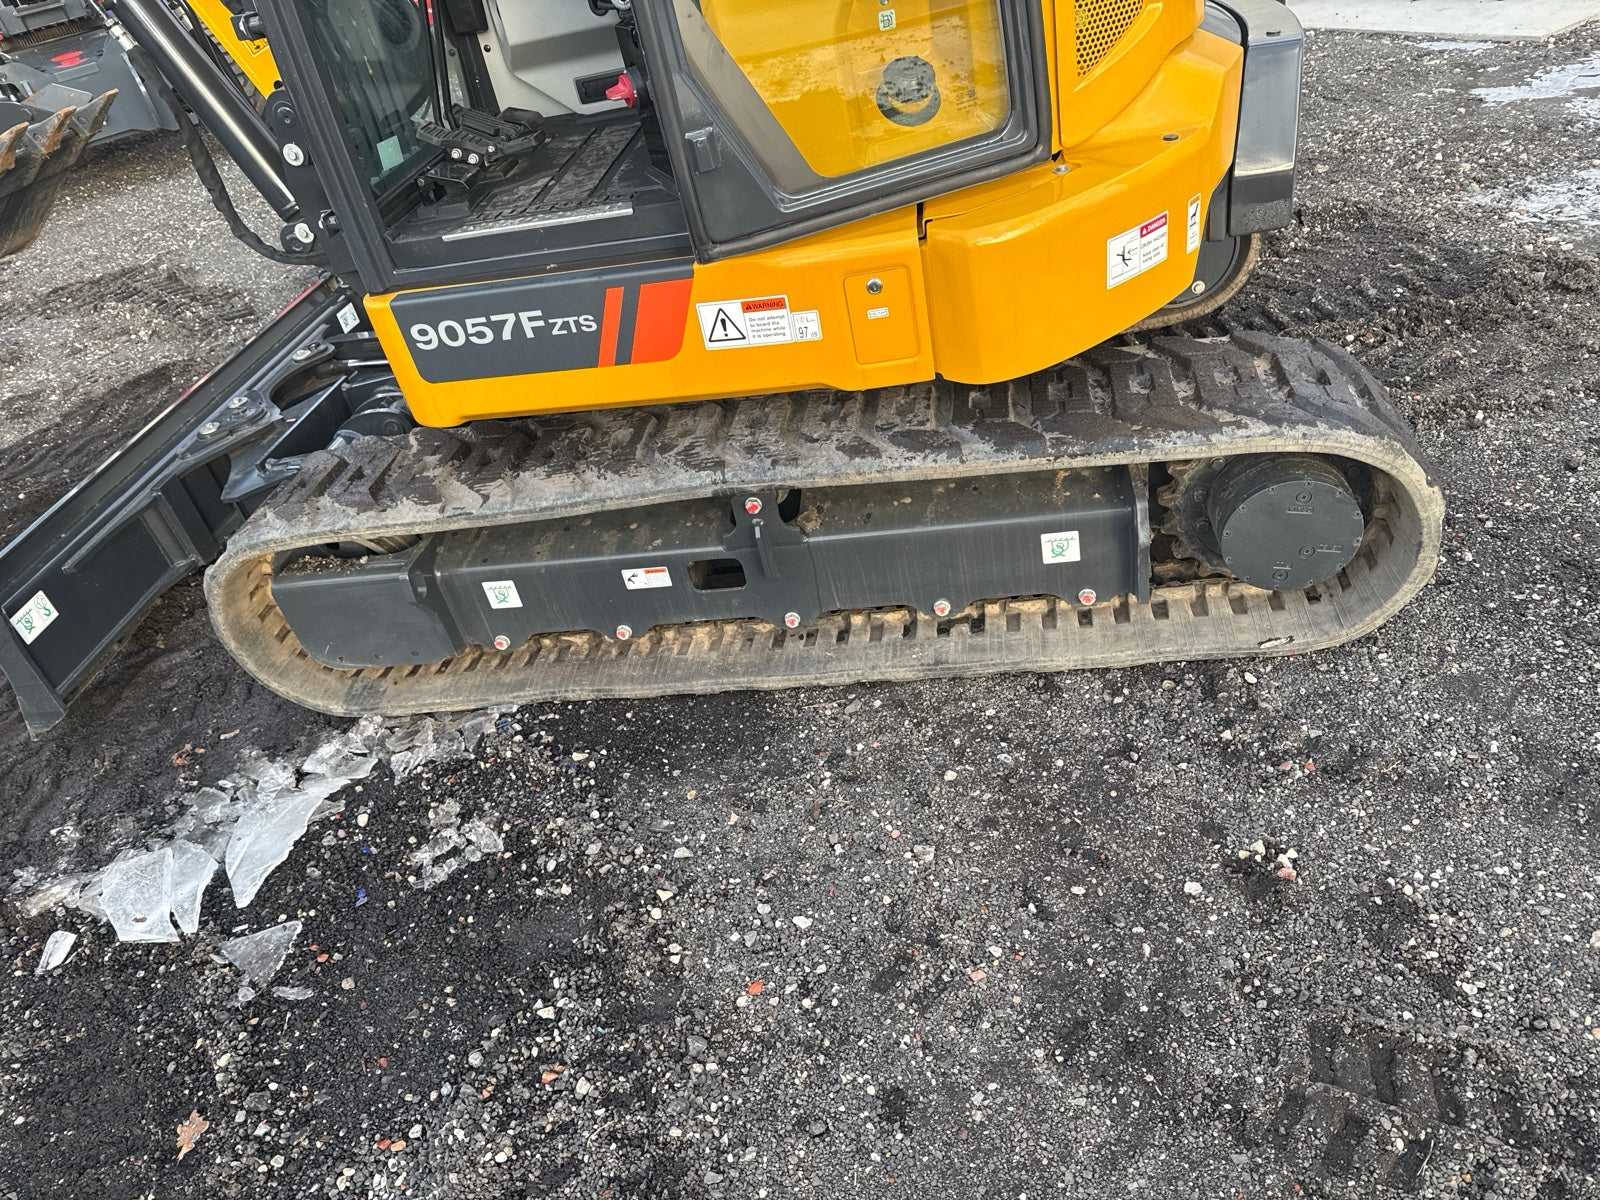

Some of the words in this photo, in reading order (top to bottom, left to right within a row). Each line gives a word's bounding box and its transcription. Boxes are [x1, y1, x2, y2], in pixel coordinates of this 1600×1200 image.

[1147, 217, 1166, 232] DANGER
[751, 300, 784, 310] WARNING
[410, 309, 546, 351] 9057F
[548, 314, 598, 336] ZTS
[798, 326, 808, 339] 97
